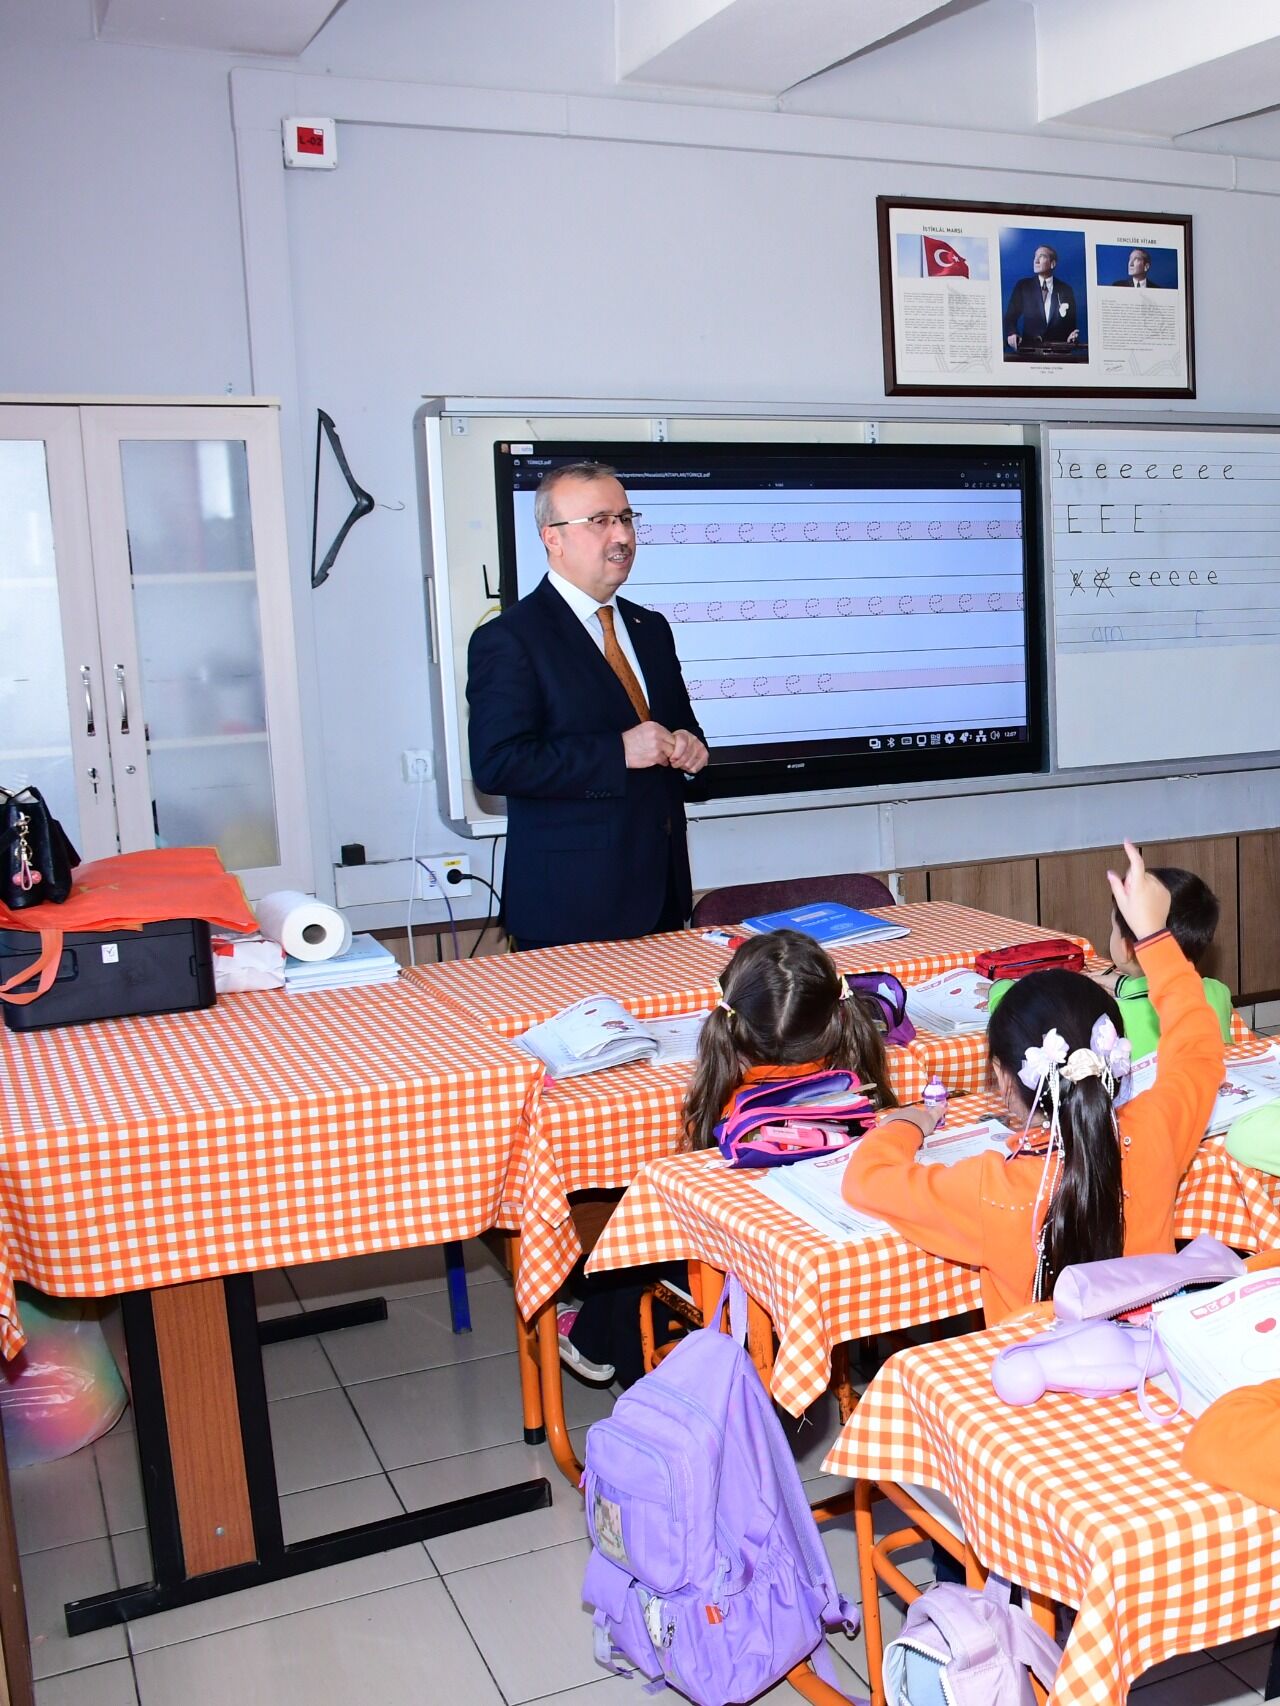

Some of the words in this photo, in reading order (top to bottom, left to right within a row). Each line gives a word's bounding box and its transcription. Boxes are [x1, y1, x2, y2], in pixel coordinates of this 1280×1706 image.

[1069, 463, 1083, 479] e
[1095, 463, 1108, 480] e
[1119, 463, 1133, 479] e
[1145, 464, 1159, 480] e
[1172, 464, 1184, 480] e
[1198, 464, 1209, 480] e
[1223, 464, 1235, 480] e
[637, 523, 654, 545] e
[671, 523, 688, 544] e
[705, 522, 722, 544] e
[738, 522, 755, 543] e
[771, 522, 788, 543] e
[803, 521, 820, 542] e
[835, 521, 851, 541] e
[867, 521, 882, 541] e
[897, 520, 913, 540] e
[927, 520, 943, 540] e
[957, 520, 973, 540] e
[986, 519, 1002, 539] e
[1067, 504, 1083, 534] E
[1100, 504, 1116, 534] E
[1133, 504, 1145, 533] E
[1129, 570, 1141, 587] e
[1148, 570, 1161, 587] e
[1169, 570, 1181, 587] e
[1189, 570, 1201, 586] e
[1207, 570, 1219, 585] e
[673, 602, 690, 623] e
[707, 601, 724, 622] e
[740, 599, 757, 620] e
[773, 599, 789, 619] e
[805, 598, 821, 618] e
[836, 596, 852, 617] e
[868, 595, 884, 615] e
[898, 595, 914, 615] e
[928, 594, 943, 614] e
[958, 593, 973, 613] e
[987, 592, 1002, 612] e
[686, 679, 704, 700] e
[720, 677, 737, 698] e
[752, 676, 769, 697] e
[785, 674, 802, 695] e
[817, 672, 833, 693] e
